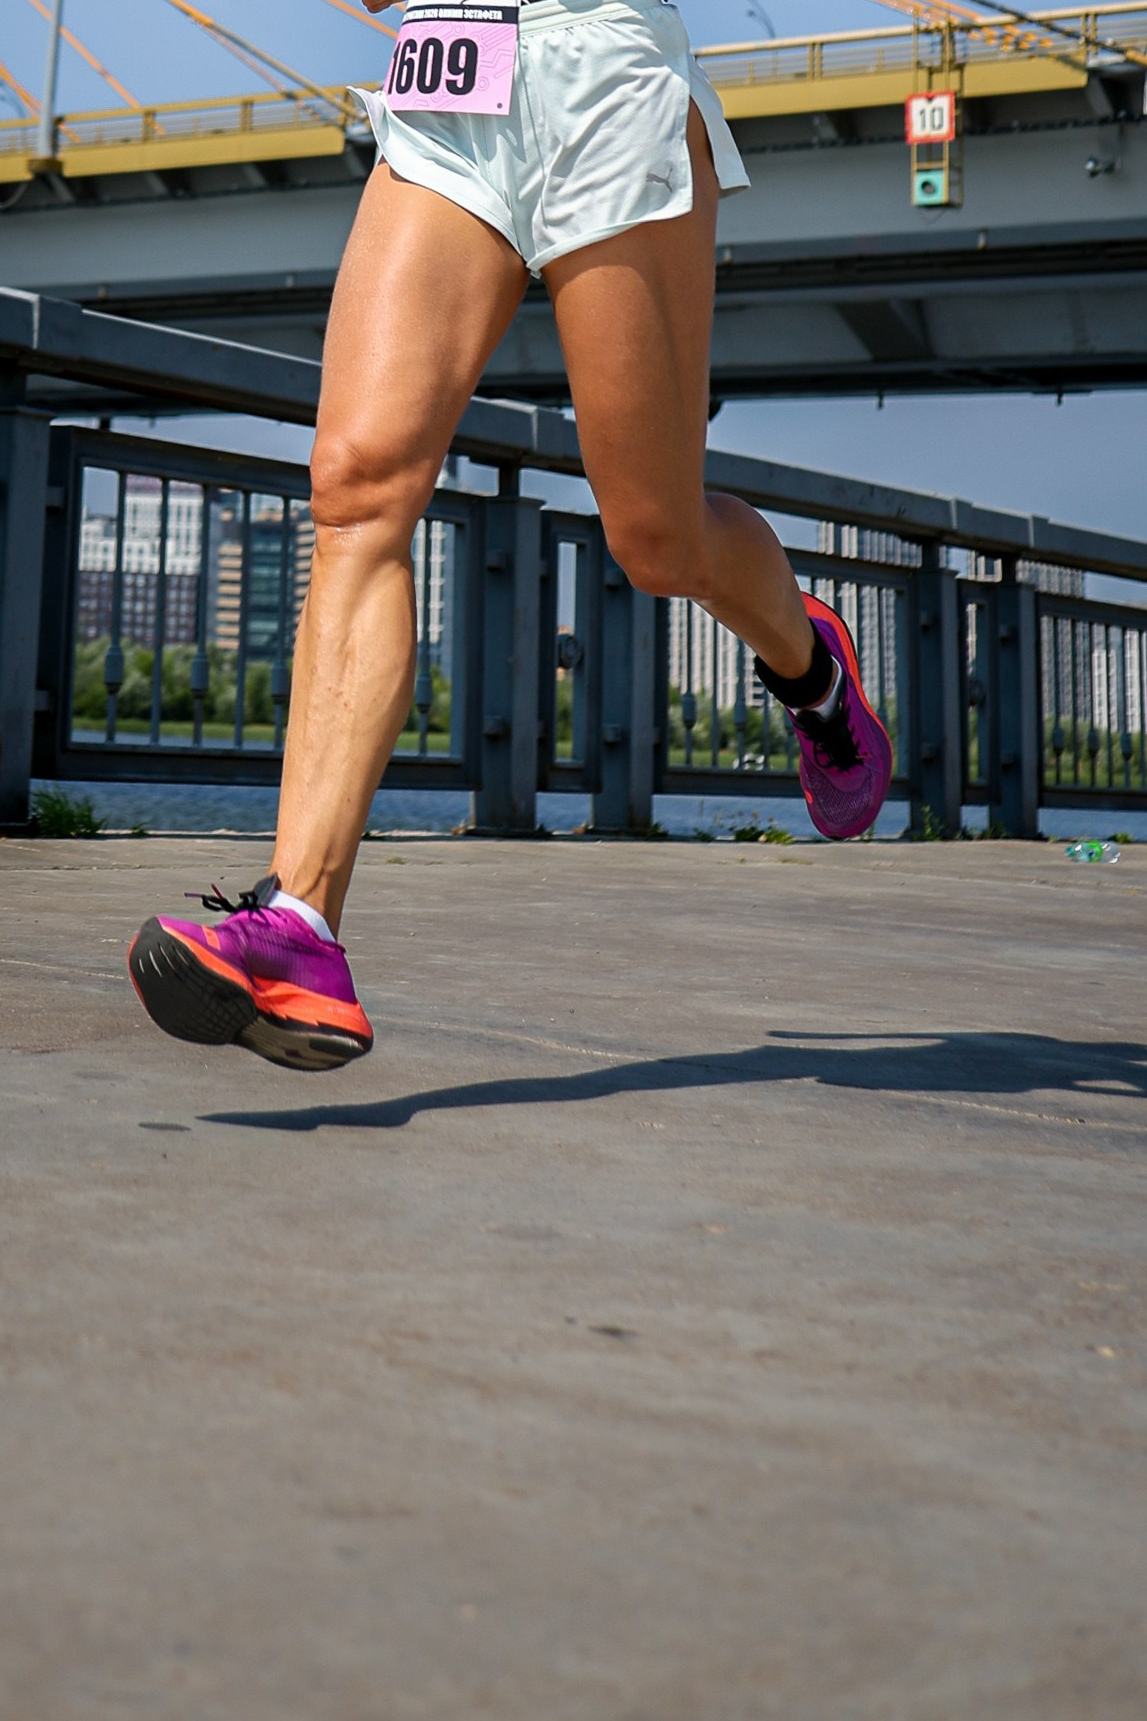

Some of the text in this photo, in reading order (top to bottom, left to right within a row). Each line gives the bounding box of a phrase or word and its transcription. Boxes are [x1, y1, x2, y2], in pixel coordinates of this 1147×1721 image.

[464, 9, 502, 20] ЭСТАФЕТА
[388, 37, 478, 96] 1609
[919, 107, 944, 132] 10
